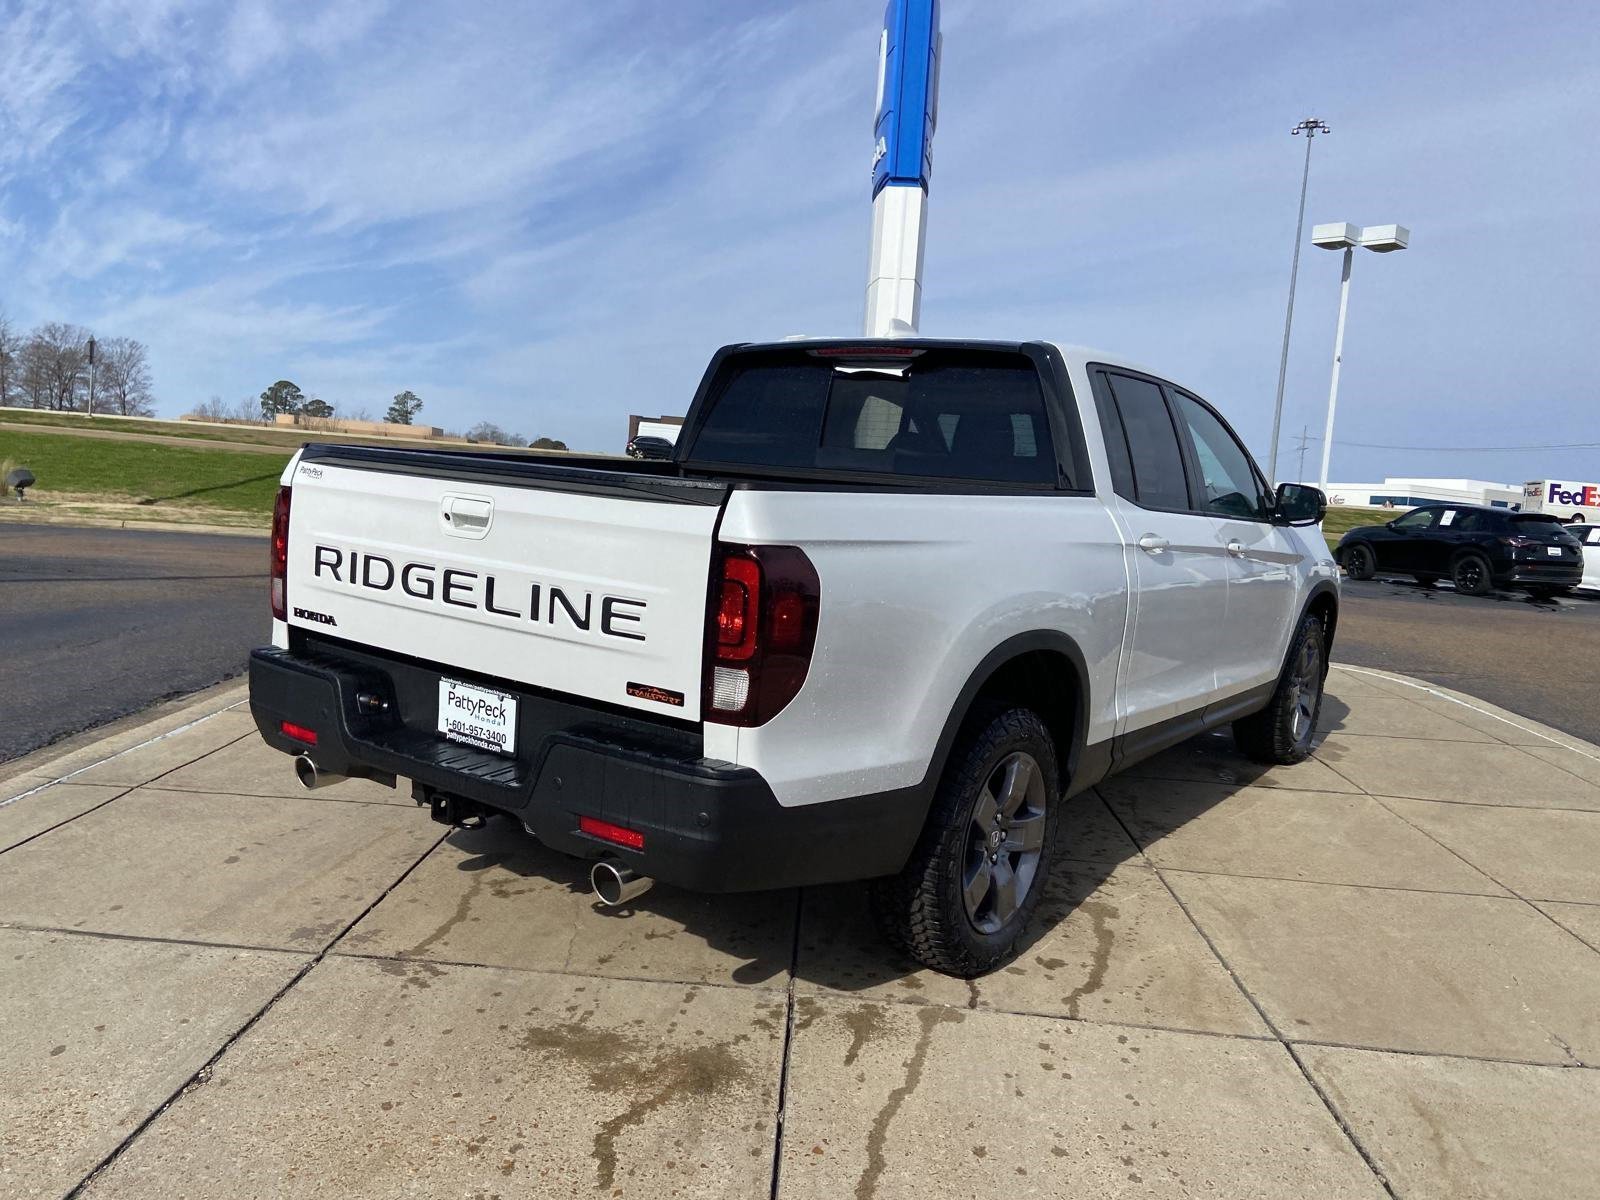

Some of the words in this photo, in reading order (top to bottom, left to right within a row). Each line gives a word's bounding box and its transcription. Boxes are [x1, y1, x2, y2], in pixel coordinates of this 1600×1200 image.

[1548, 483, 1600, 507] FedE
[314, 545, 646, 641] RIDGELINE
[293, 607, 337, 626] HONDA
[448, 691, 506, 726] PattyPeck
[474, 714, 501, 726] Honda
[445, 718, 507, 744] 1-601-957-3400
[446, 732, 501, 753] pattypeckhonda.com
